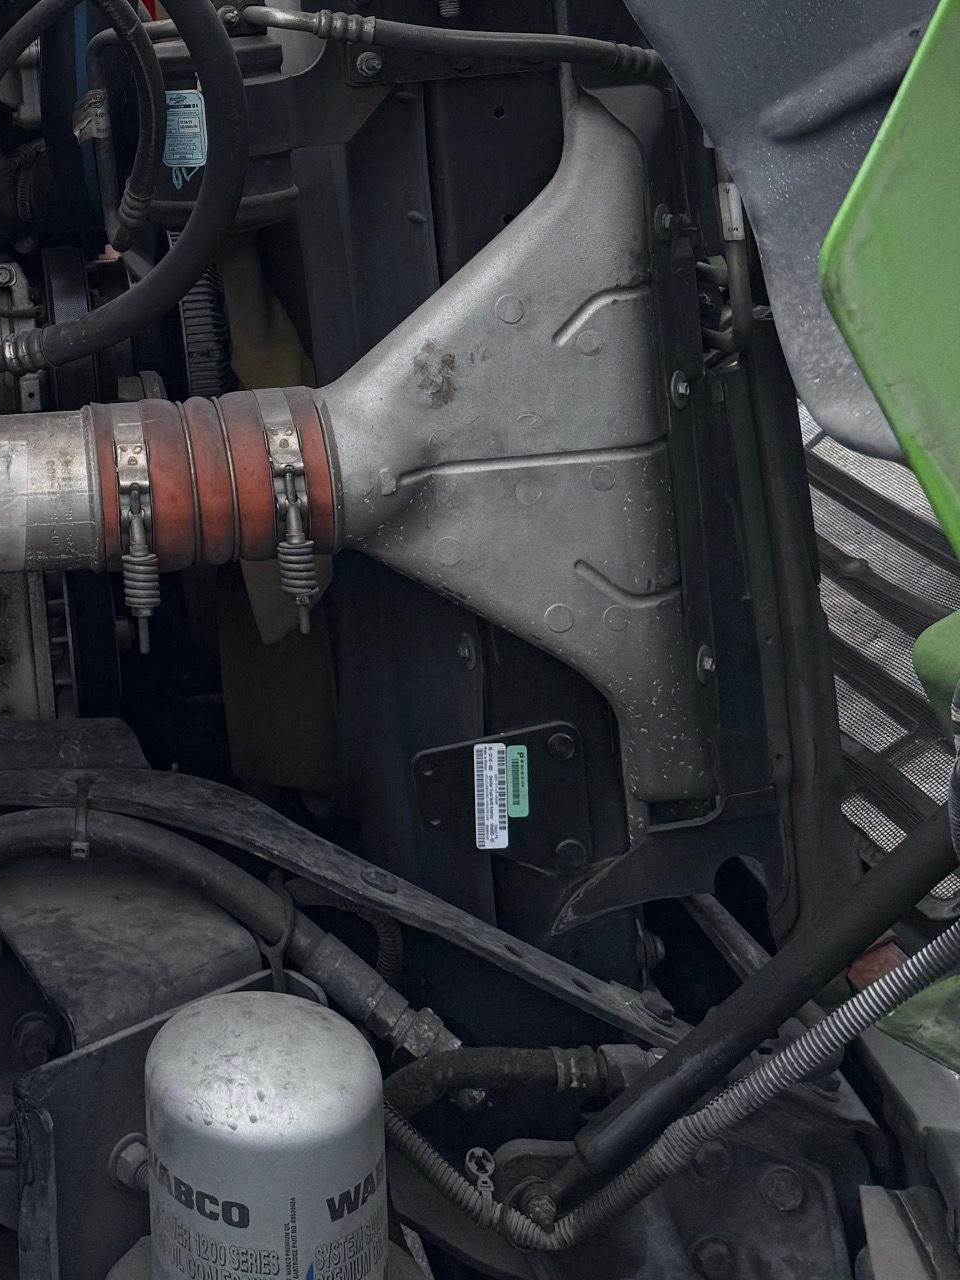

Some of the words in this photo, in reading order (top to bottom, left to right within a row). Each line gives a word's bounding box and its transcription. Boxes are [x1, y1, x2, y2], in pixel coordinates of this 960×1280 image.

[195, 1231, 227, 1267] 1200
[229, 1244, 280, 1276] SERIES
[314, 1224, 365, 1271] SYSTEM
